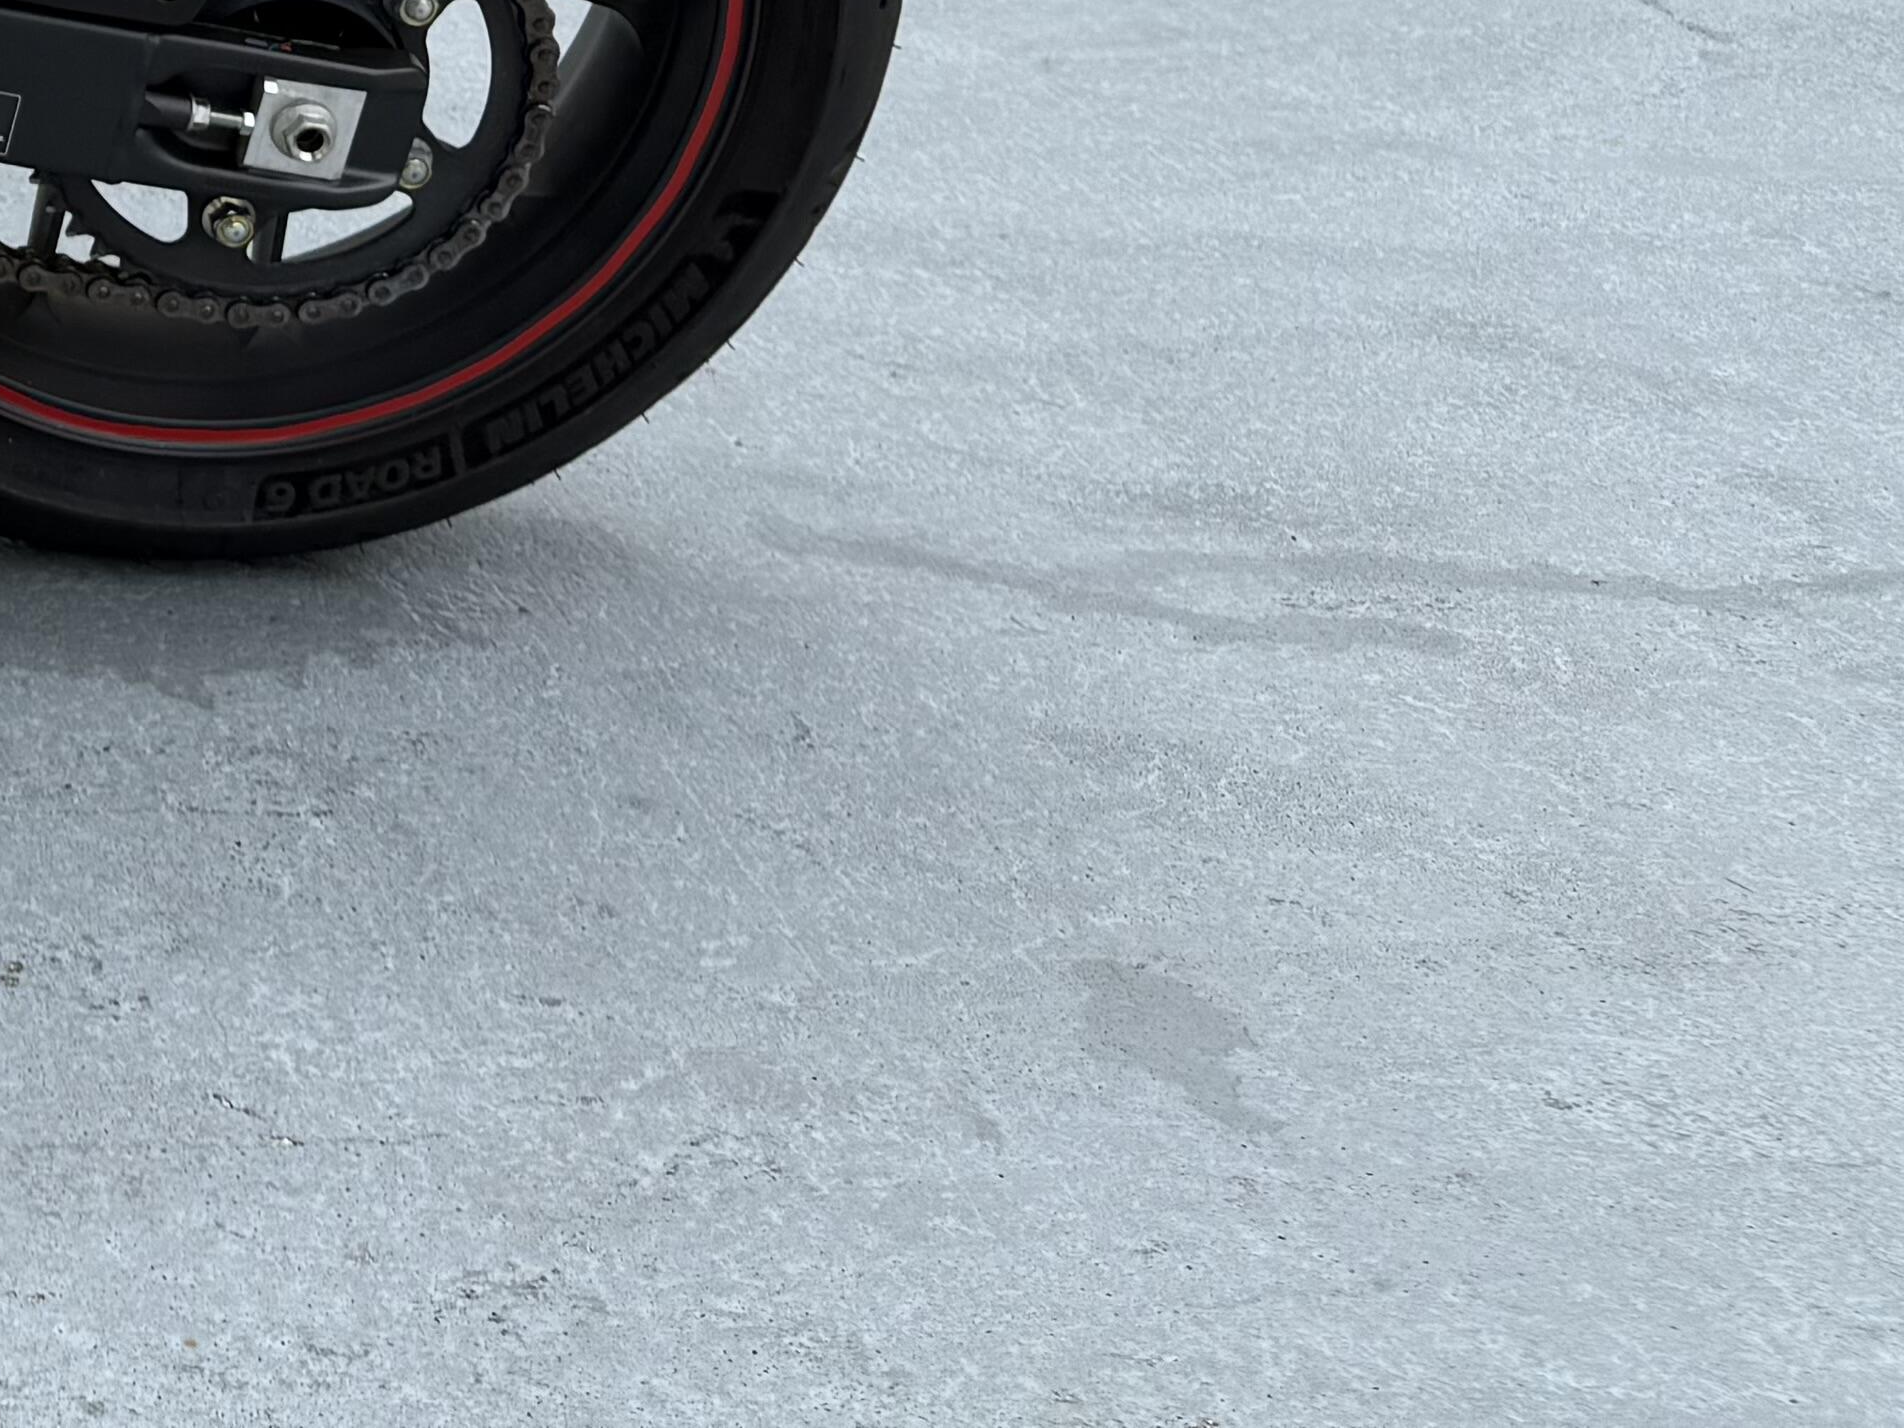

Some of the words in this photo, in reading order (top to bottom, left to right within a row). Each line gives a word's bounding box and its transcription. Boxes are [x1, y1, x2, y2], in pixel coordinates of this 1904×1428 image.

[482, 261, 711, 455] MICHELIN
[265, 480, 298, 513] 6
[309, 445, 444, 510] ROAD
